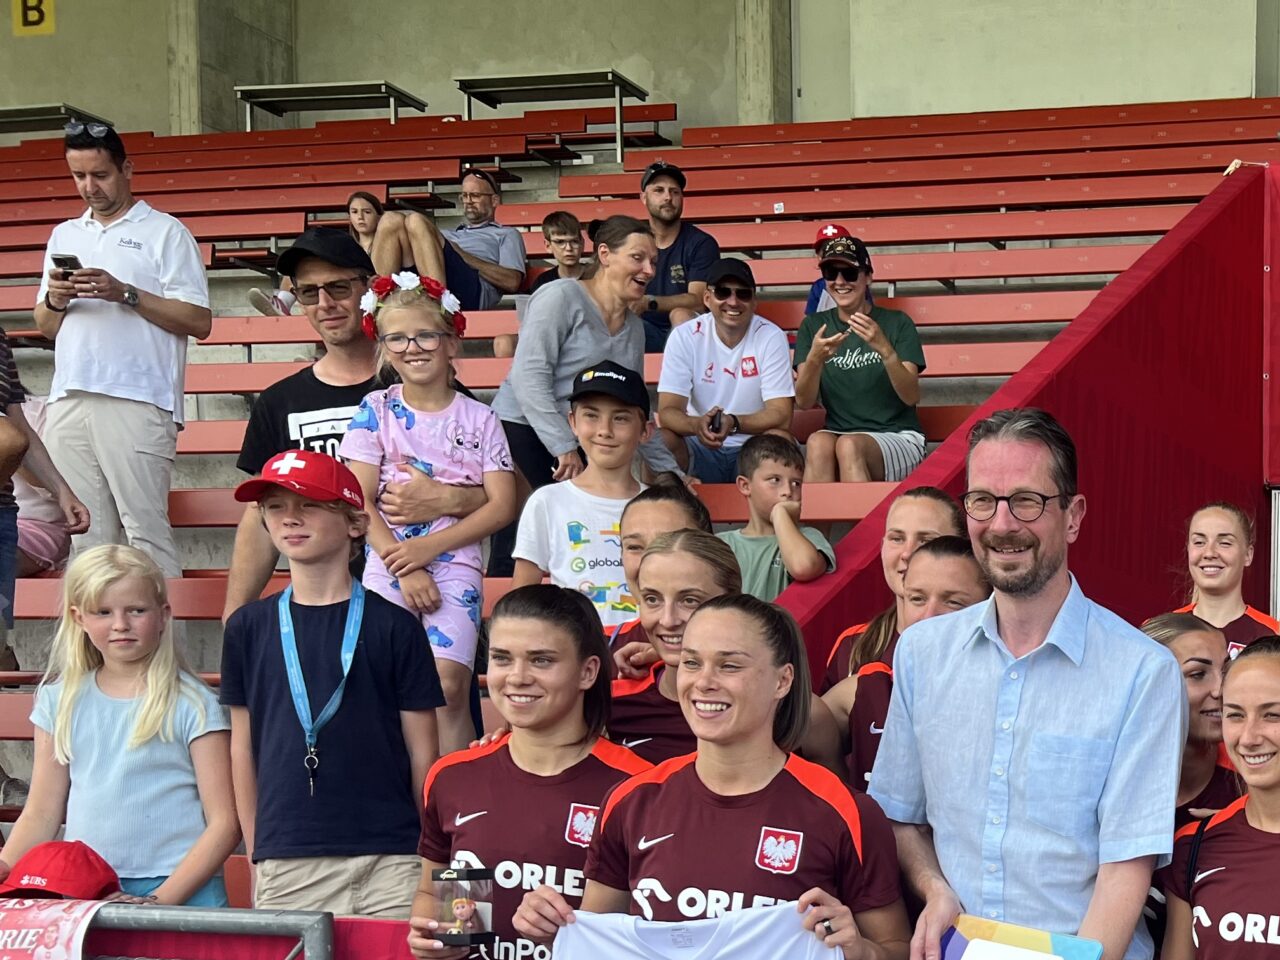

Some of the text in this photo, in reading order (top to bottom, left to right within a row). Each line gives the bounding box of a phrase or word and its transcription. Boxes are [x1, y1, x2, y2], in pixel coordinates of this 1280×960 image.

[21, 0, 45, 27] B
[29, 875, 48, 887] UBS
[494, 860, 588, 897] ORLE
